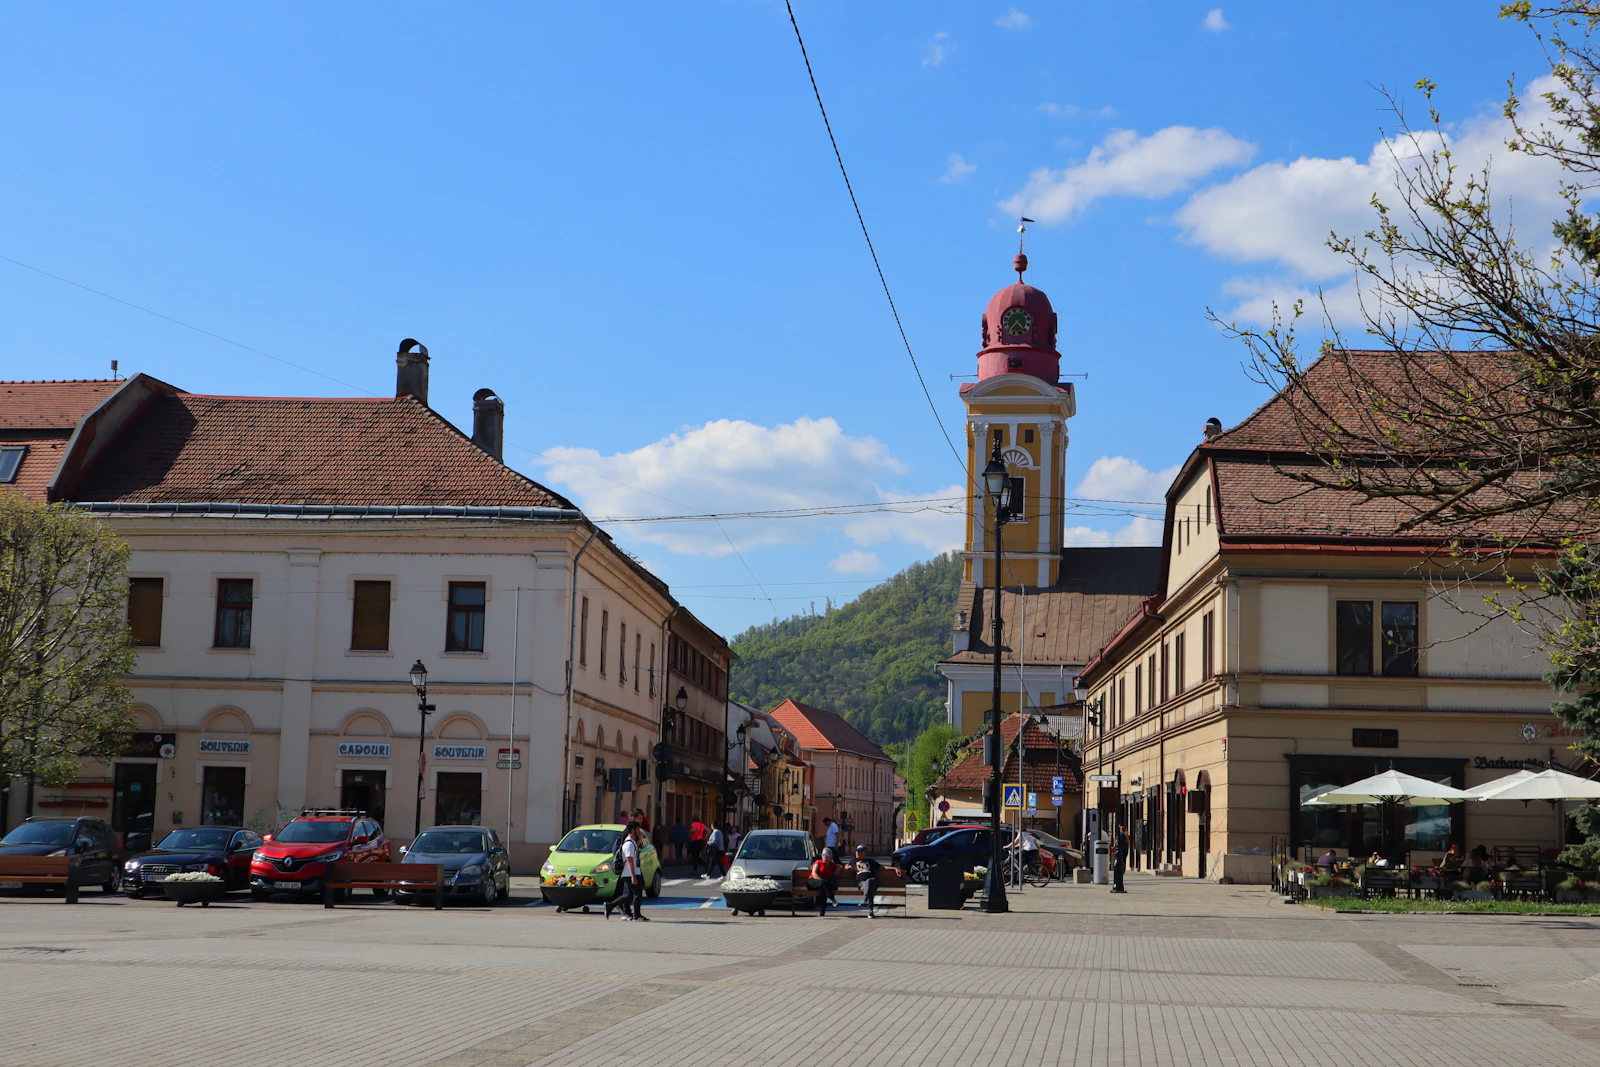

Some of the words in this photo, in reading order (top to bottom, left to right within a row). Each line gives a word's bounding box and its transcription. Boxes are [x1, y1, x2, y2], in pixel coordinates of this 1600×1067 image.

[200, 741, 250, 753] SOUVENIR
[339, 744, 389, 756] CADOURI
[434, 747, 485, 758] SOUVENIR
